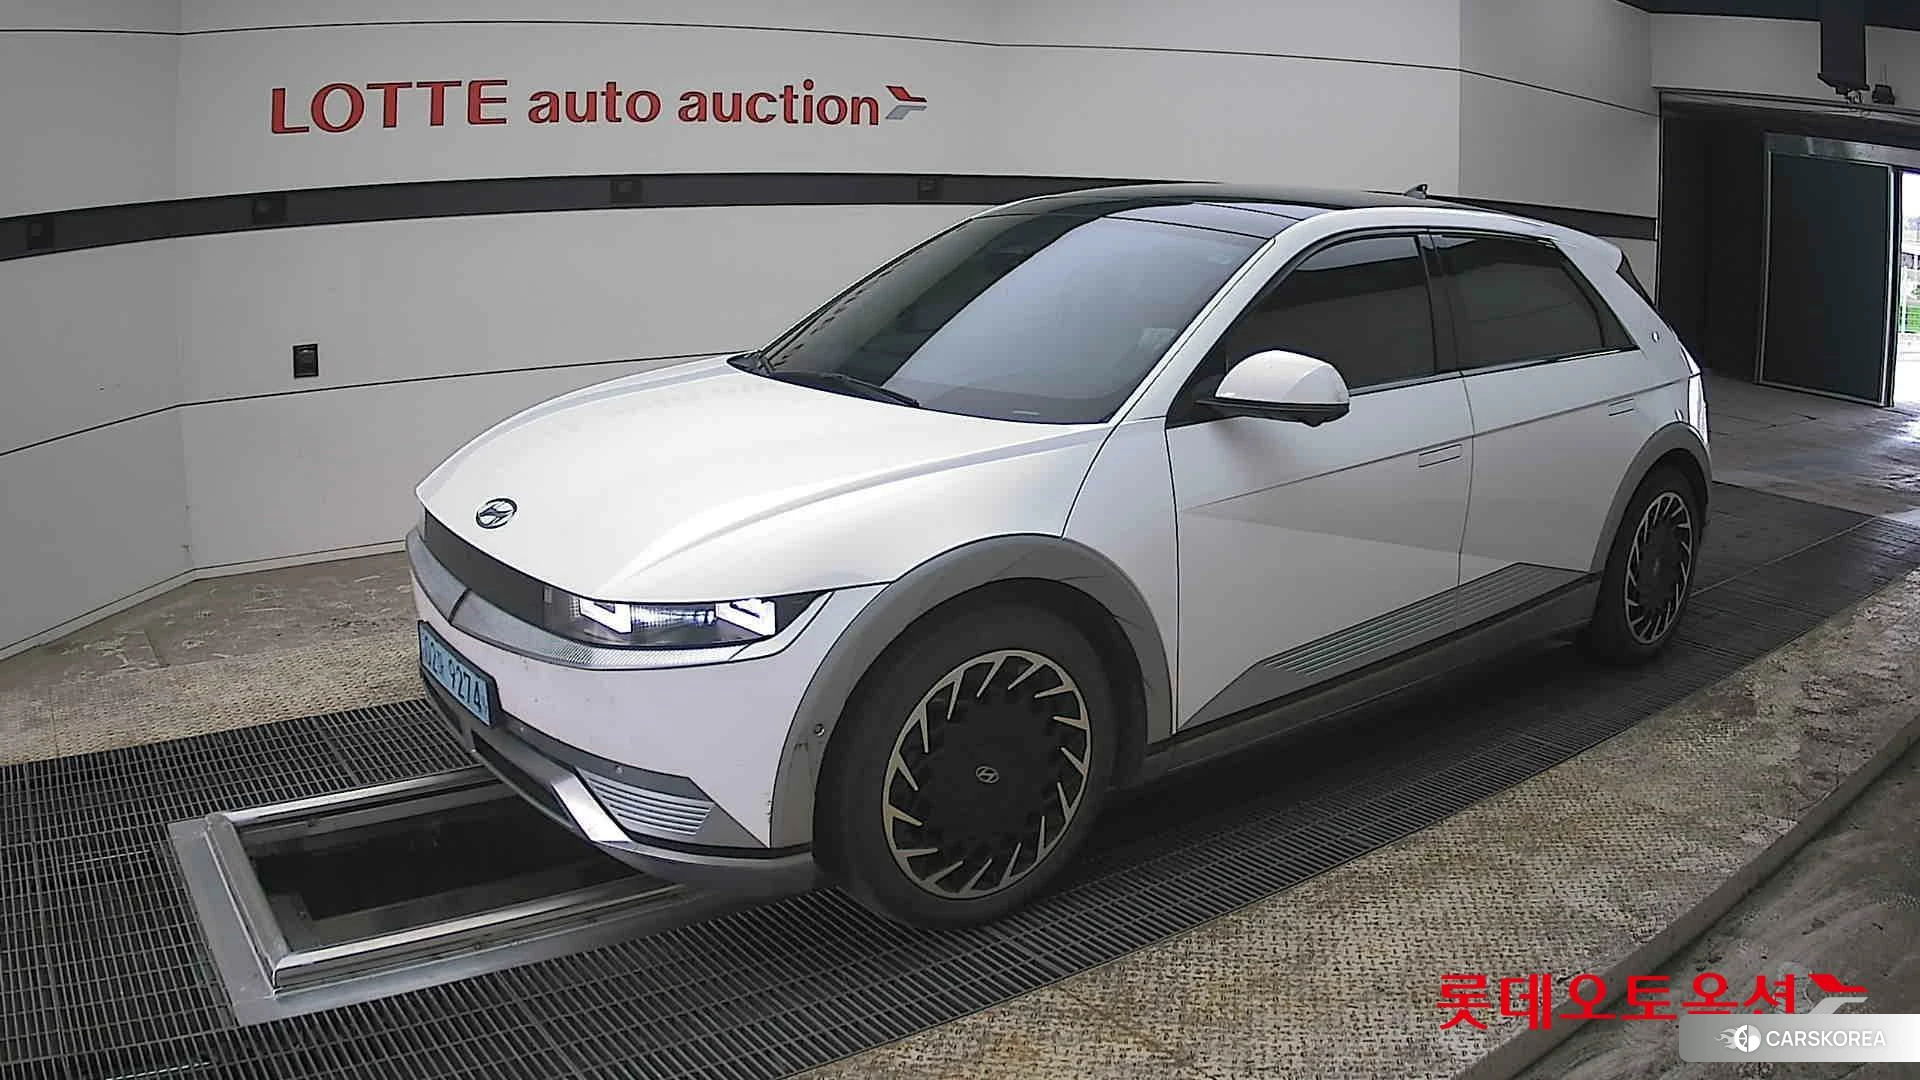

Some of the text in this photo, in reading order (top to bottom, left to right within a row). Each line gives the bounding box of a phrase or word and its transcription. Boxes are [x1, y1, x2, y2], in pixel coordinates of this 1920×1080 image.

[271, 79, 880, 134] LOTTE auto auction
[448, 659, 482, 713] 9274
